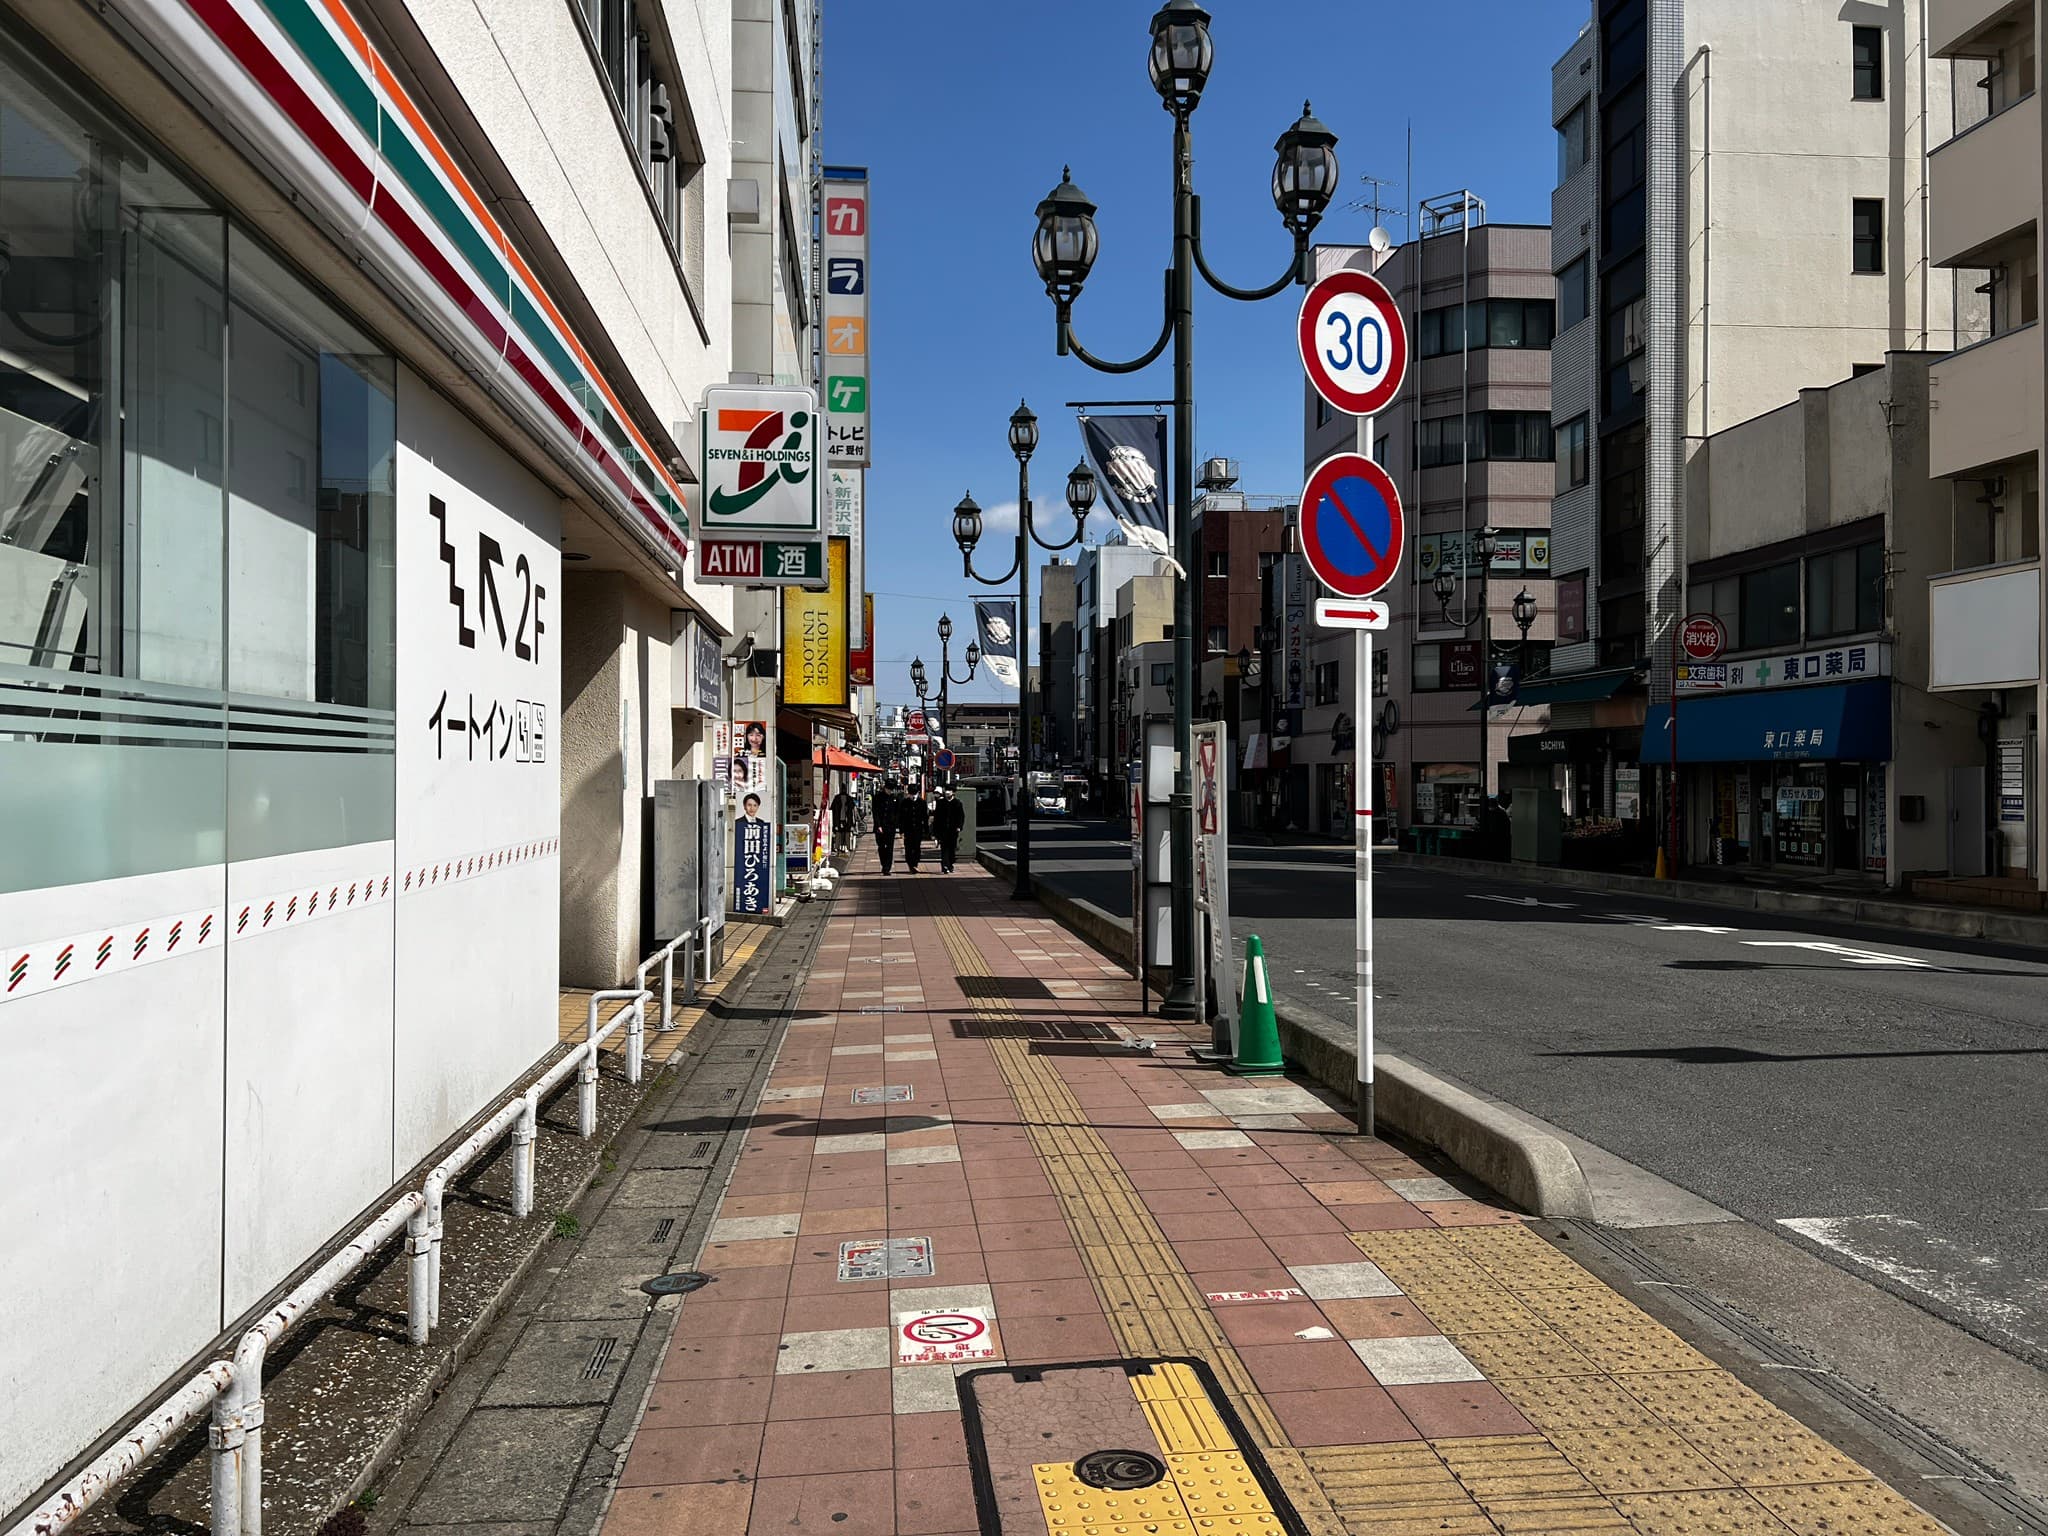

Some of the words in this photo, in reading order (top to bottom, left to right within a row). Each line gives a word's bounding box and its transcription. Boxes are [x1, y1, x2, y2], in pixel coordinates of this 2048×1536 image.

[831, 203, 860, 408] カラオケ
[1327, 311, 1383, 375] 30
[828, 426, 864, 441] トレビ
[756, 450, 810, 462] HOLDINGS
[828, 447, 844, 455] 4F
[846, 446, 864, 456] 受付
[707, 545, 755, 573] ATM
[777, 545, 807, 576] 酒
[515, 553, 546, 665] 2F
[803, 610, 815, 686] UNLOCK
[817, 610, 829, 686] LOUNGE
[1686, 631, 1717, 646] 消火栓
[1688, 666, 1726, 680] 文京歯科
[1783, 647, 1866, 681] 東口薬局
[429, 690, 513, 762] イートイン
[1764, 729, 1824, 748] 東口薬局
[1540, 741, 1565, 751] SACHIYA
[744, 823, 760, 912] 前田ひろあき
